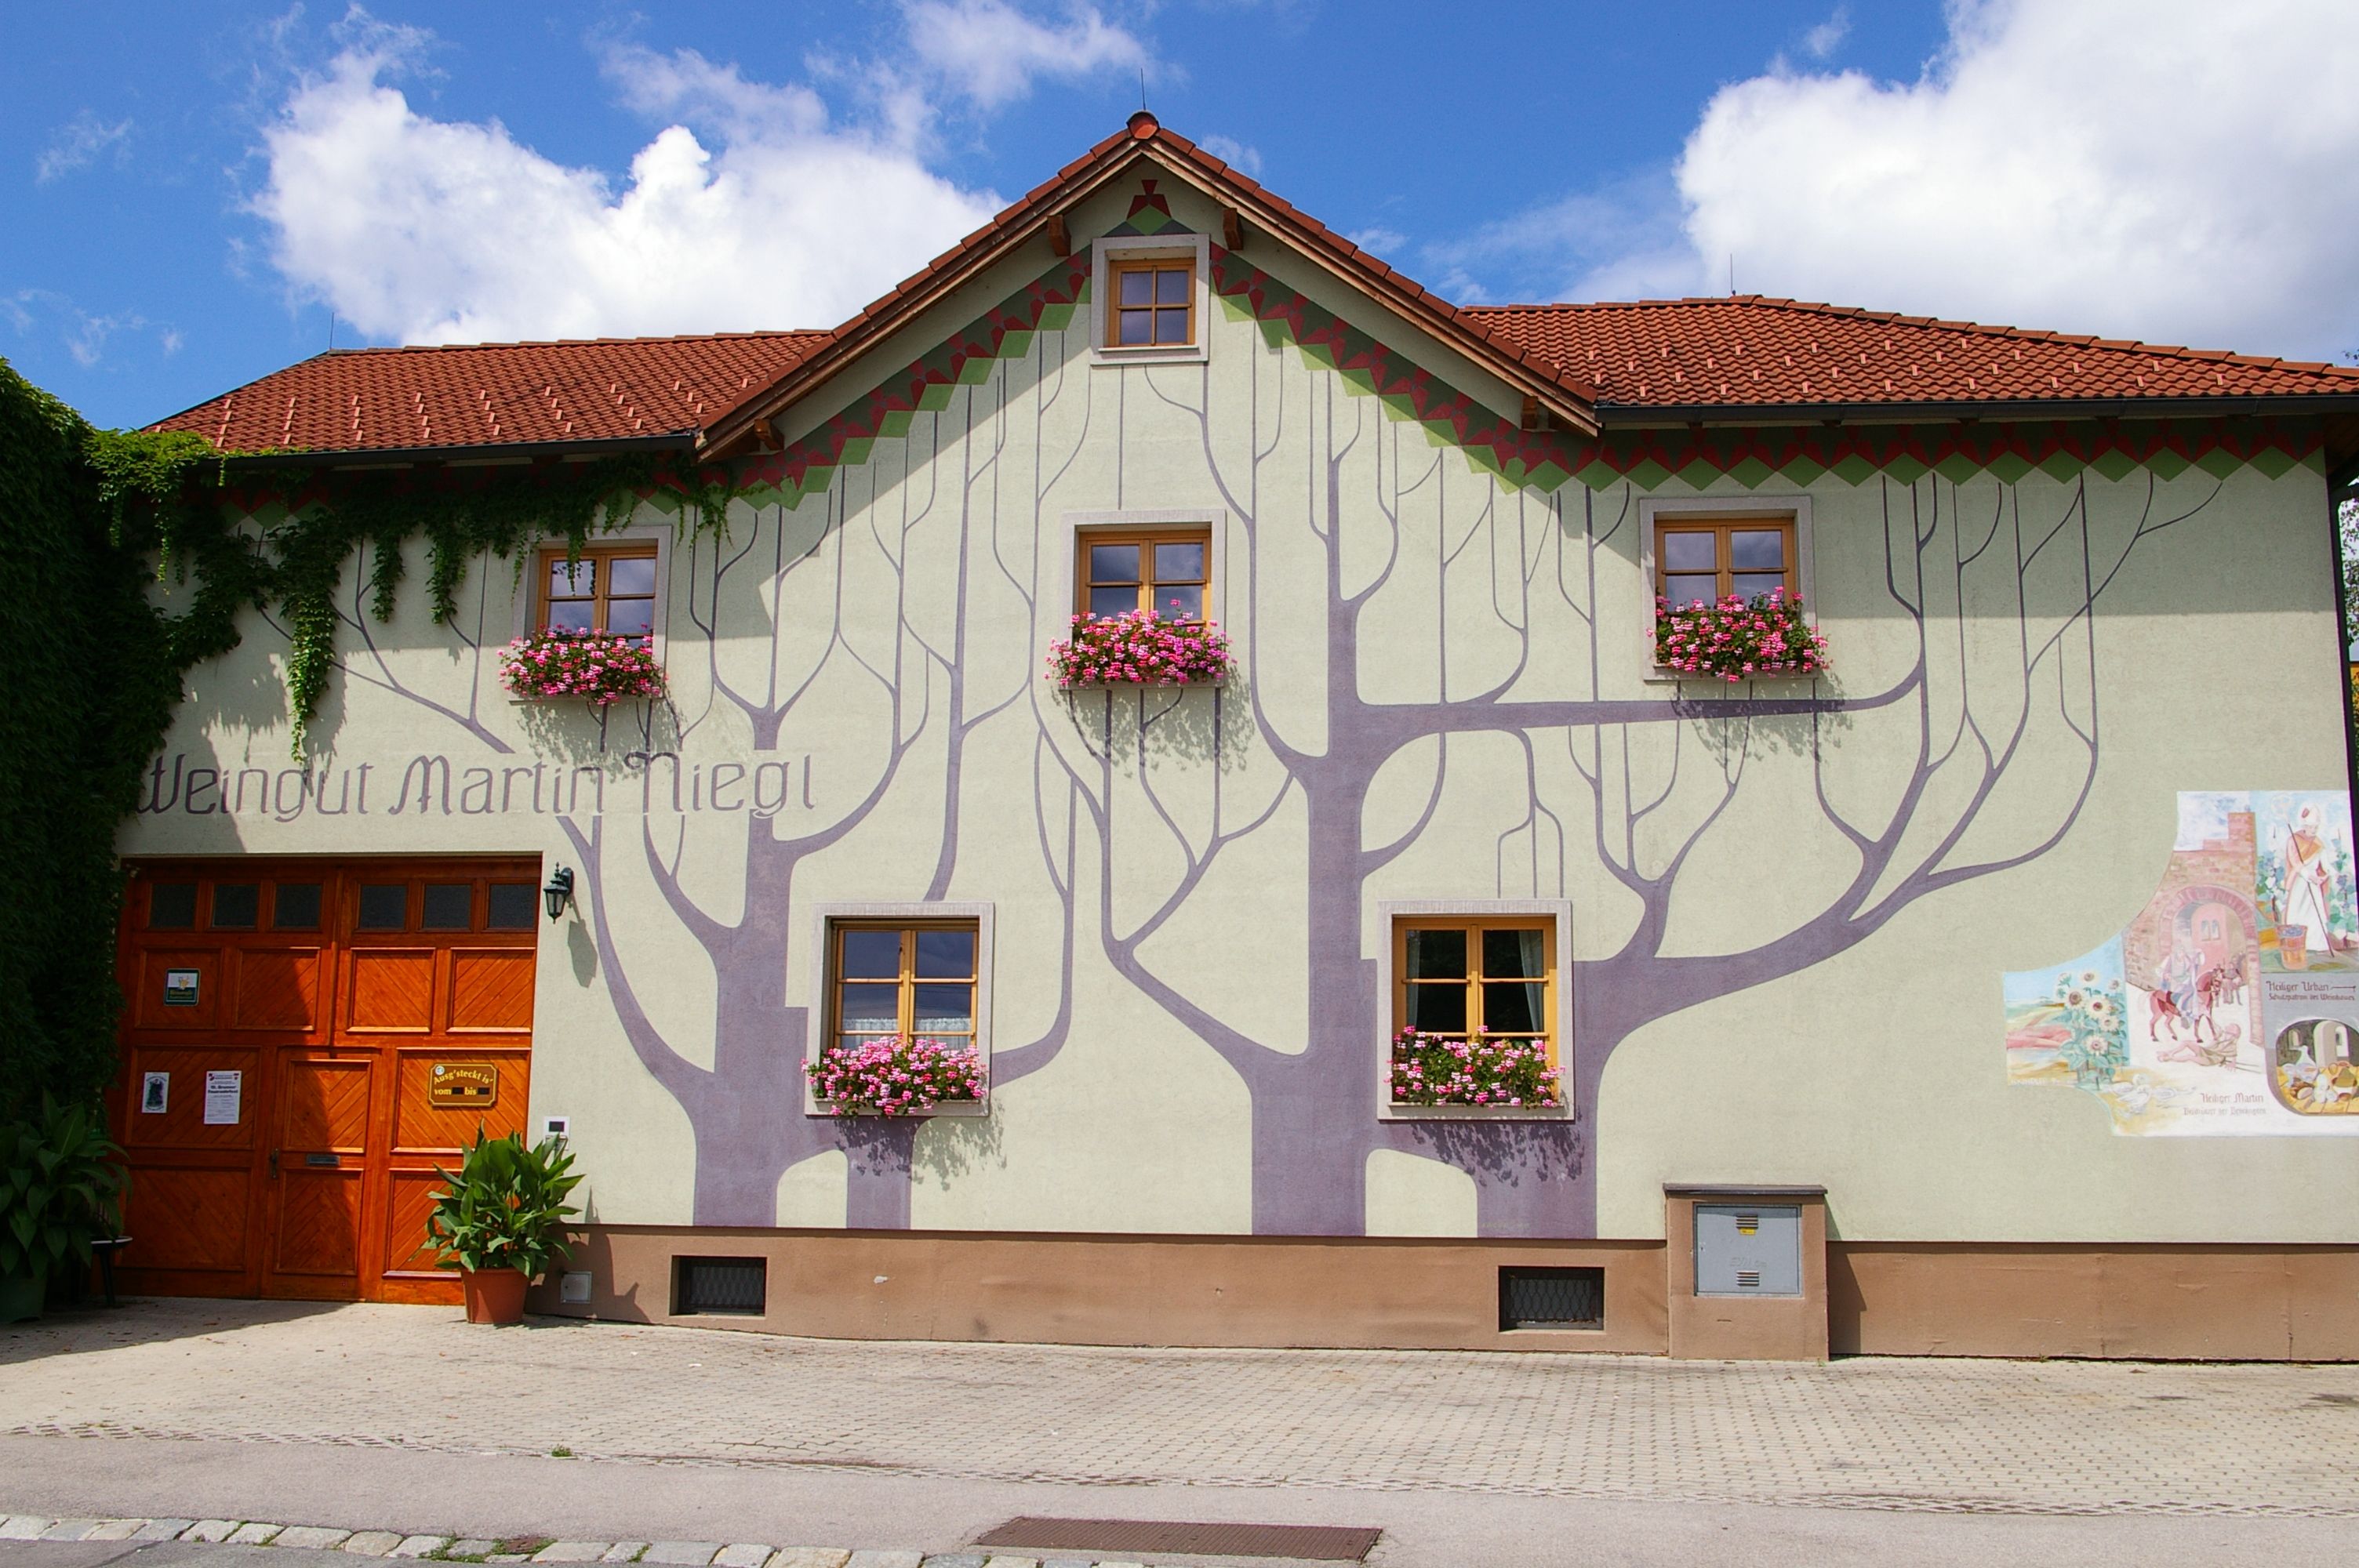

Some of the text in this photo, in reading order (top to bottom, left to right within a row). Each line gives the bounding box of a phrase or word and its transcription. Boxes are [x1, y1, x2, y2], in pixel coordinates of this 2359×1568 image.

[136, 751, 816, 822] Weingut Martin Niegl
[2301, 981, 2328, 991] Urban
[464, 1087, 477, 1095] bis
[2234, 1092, 2264, 1103] Martin
